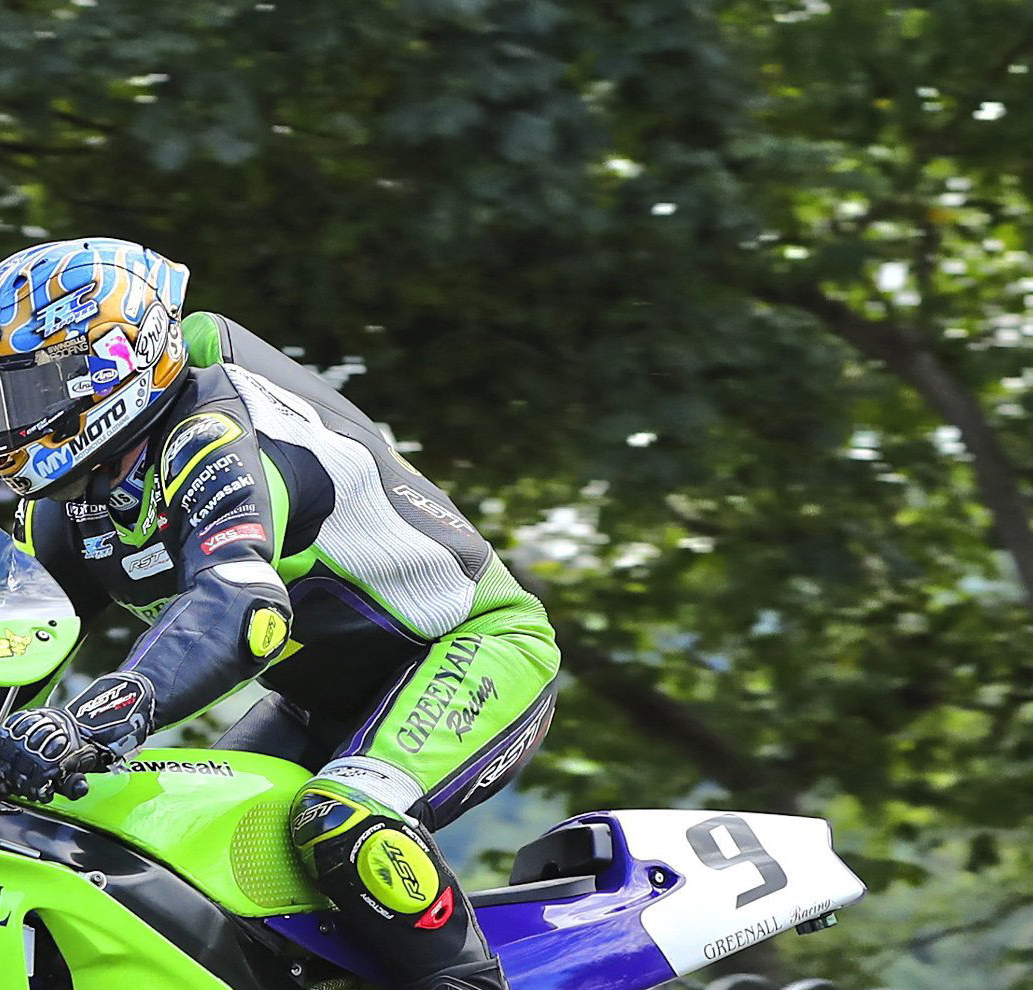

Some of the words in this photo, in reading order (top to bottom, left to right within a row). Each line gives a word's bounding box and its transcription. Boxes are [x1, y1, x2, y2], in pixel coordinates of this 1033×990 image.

[189, 474, 255, 528] Kawasaki
[129, 549, 167, 573] RST
[446, 674, 499, 743] Racing
[111, 758, 235, 777] Kawasaki
[380, 840, 427, 901] RST
[685, 814, 788, 909] 9
[703, 916, 783, 960] GREENALL
[789, 899, 832, 924] Racing
